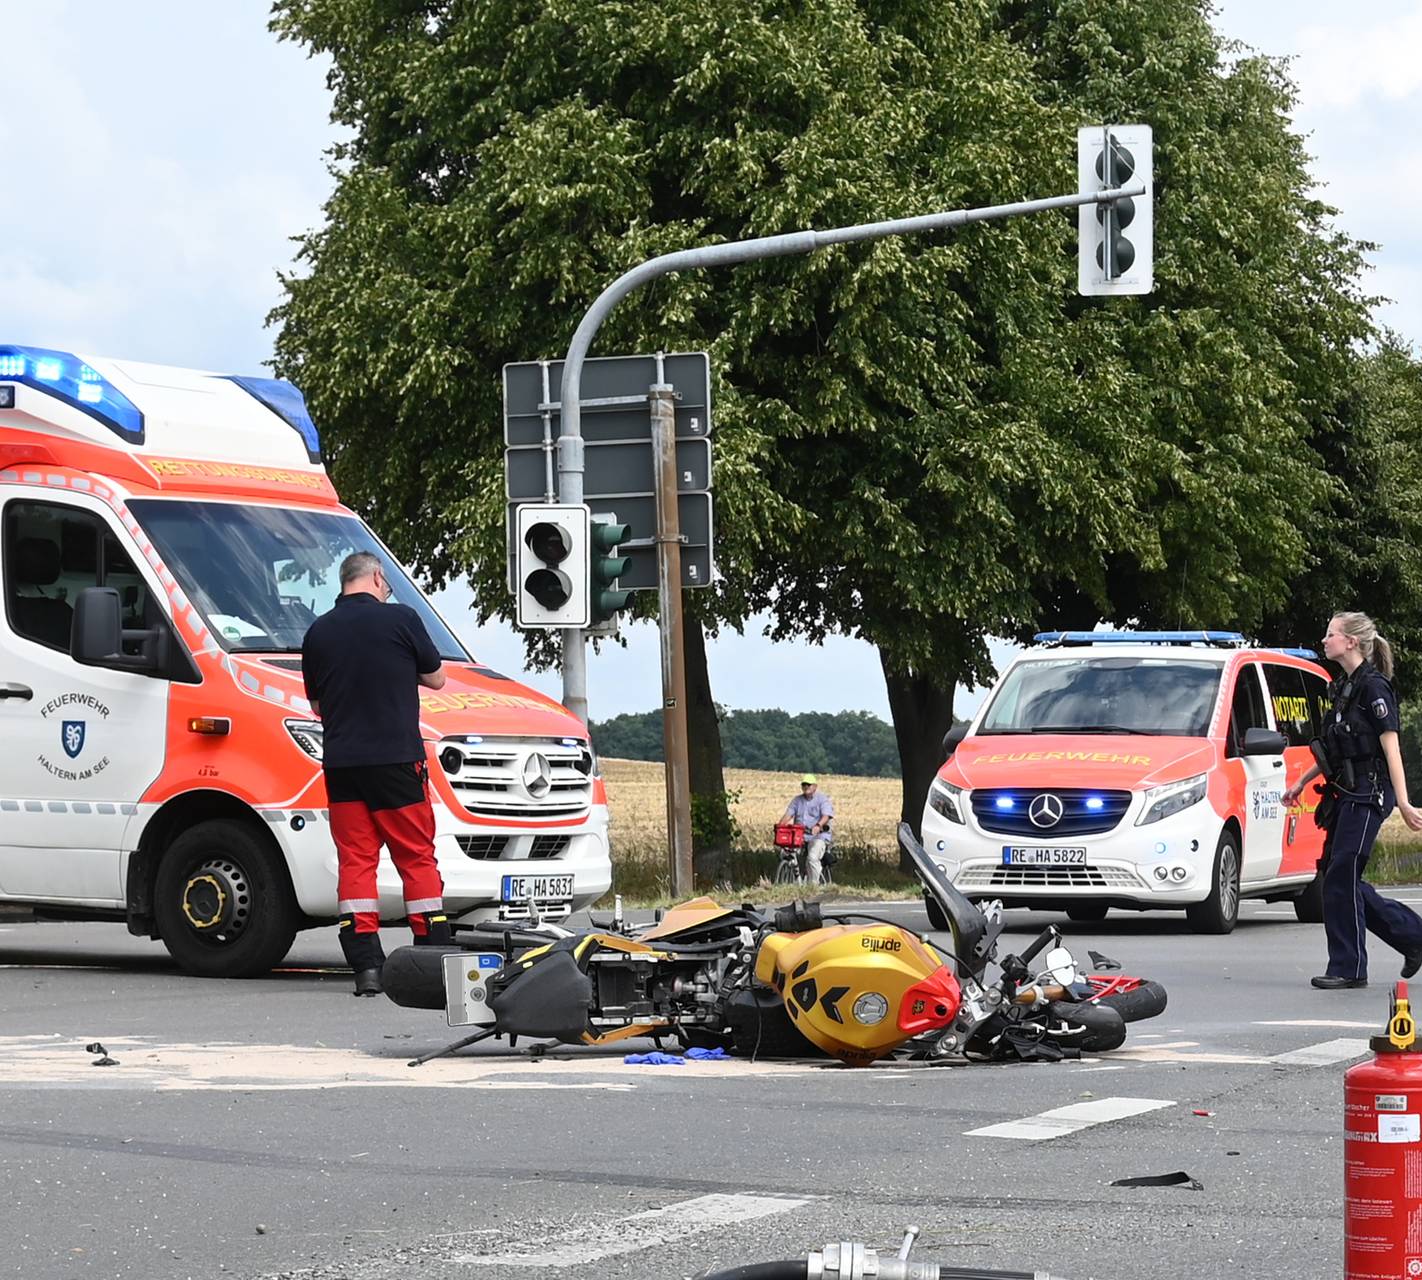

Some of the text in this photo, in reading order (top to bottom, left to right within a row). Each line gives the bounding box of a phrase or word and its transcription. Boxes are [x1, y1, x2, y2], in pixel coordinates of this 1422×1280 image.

[150, 460, 323, 489] RETTUNGSDIENST
[40, 692, 110, 719] FEUERWEHR
[1272, 695, 1310, 722] NOTARZT
[37, 754, 111, 781] HALTERN AM SEE
[972, 751, 1152, 766] FEUERWEHR
[1012, 849, 1084, 863] RE HA 5822
[512, 878, 573, 897] RE HA 5831
[861, 938, 901, 952] aprilia
